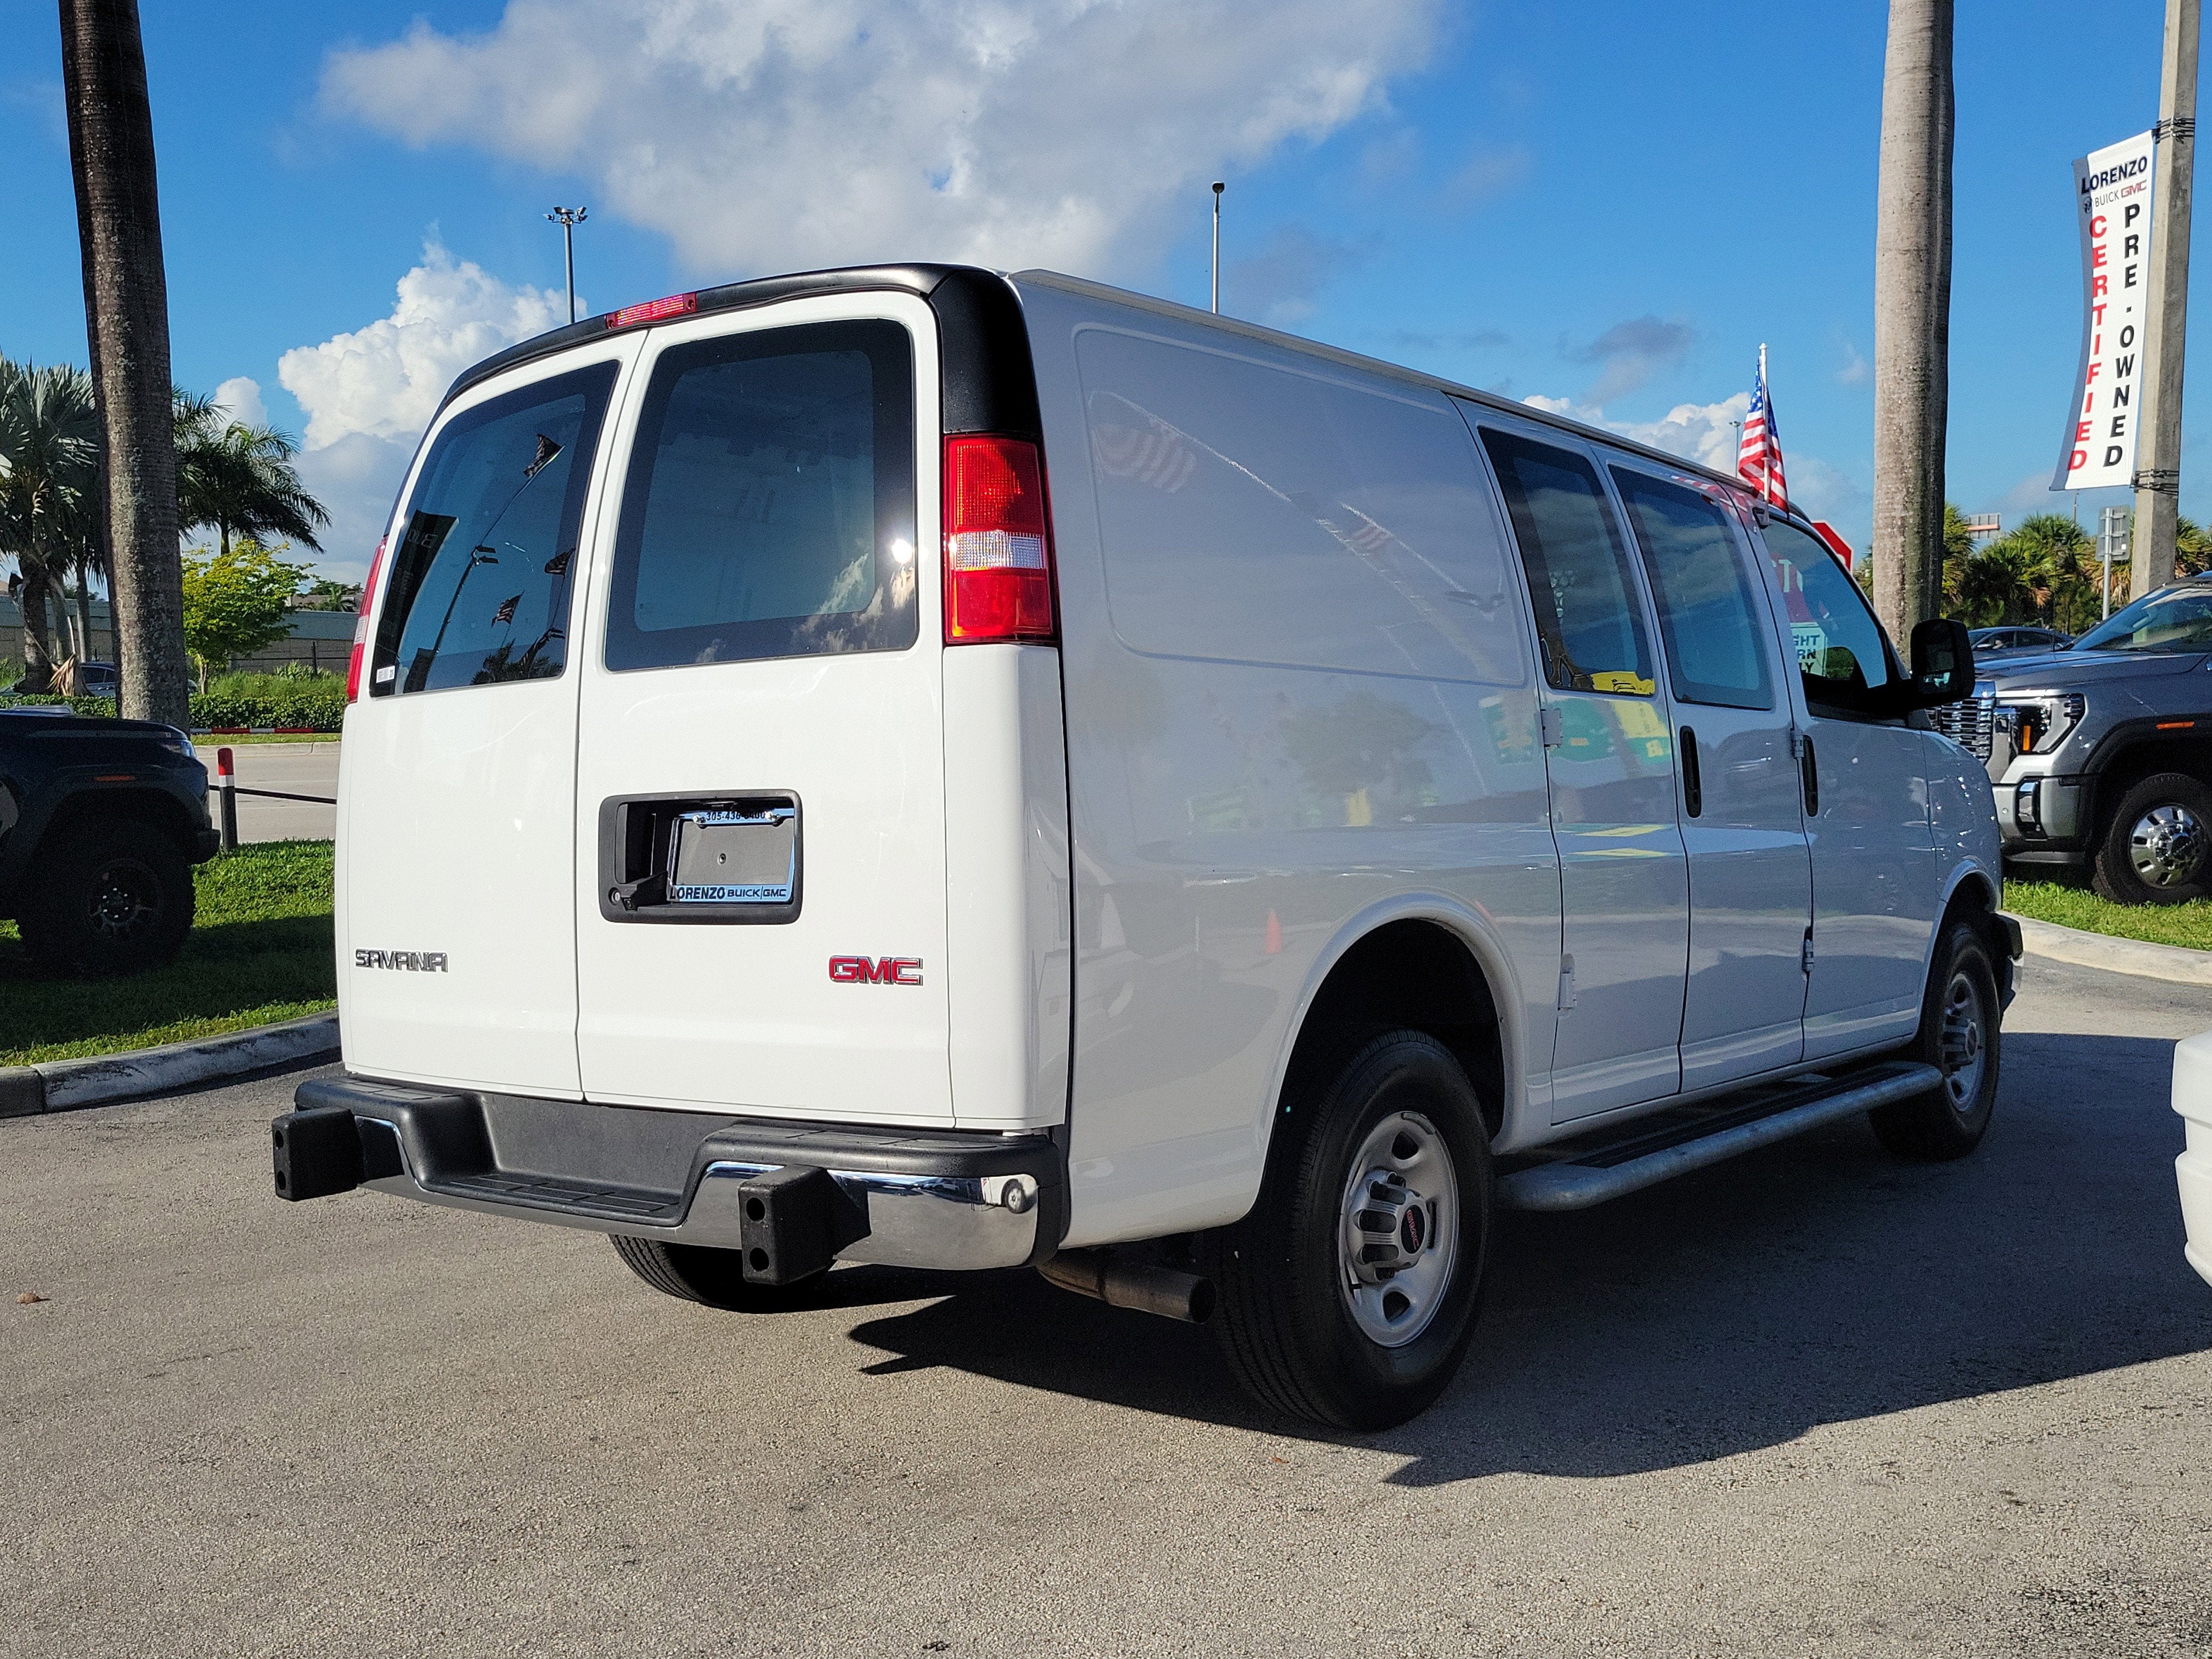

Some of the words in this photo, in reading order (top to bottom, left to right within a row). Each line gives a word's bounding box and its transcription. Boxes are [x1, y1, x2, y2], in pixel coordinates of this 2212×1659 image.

[2081, 156, 2148, 194] LORENZO
[2095, 190, 2119, 207] BUICK
[2121, 179, 2147, 198] GMC
[2067, 215, 2107, 470] CERTIFIED
[1793, 635, 1820, 646] GHT
[1797, 648, 1816, 659] RN
[669, 887, 725, 899] LORENZO
[356, 949, 448, 973] SAVANA
[829, 955, 923, 986] GMC
[1407, 1209, 1419, 1250] GMC
